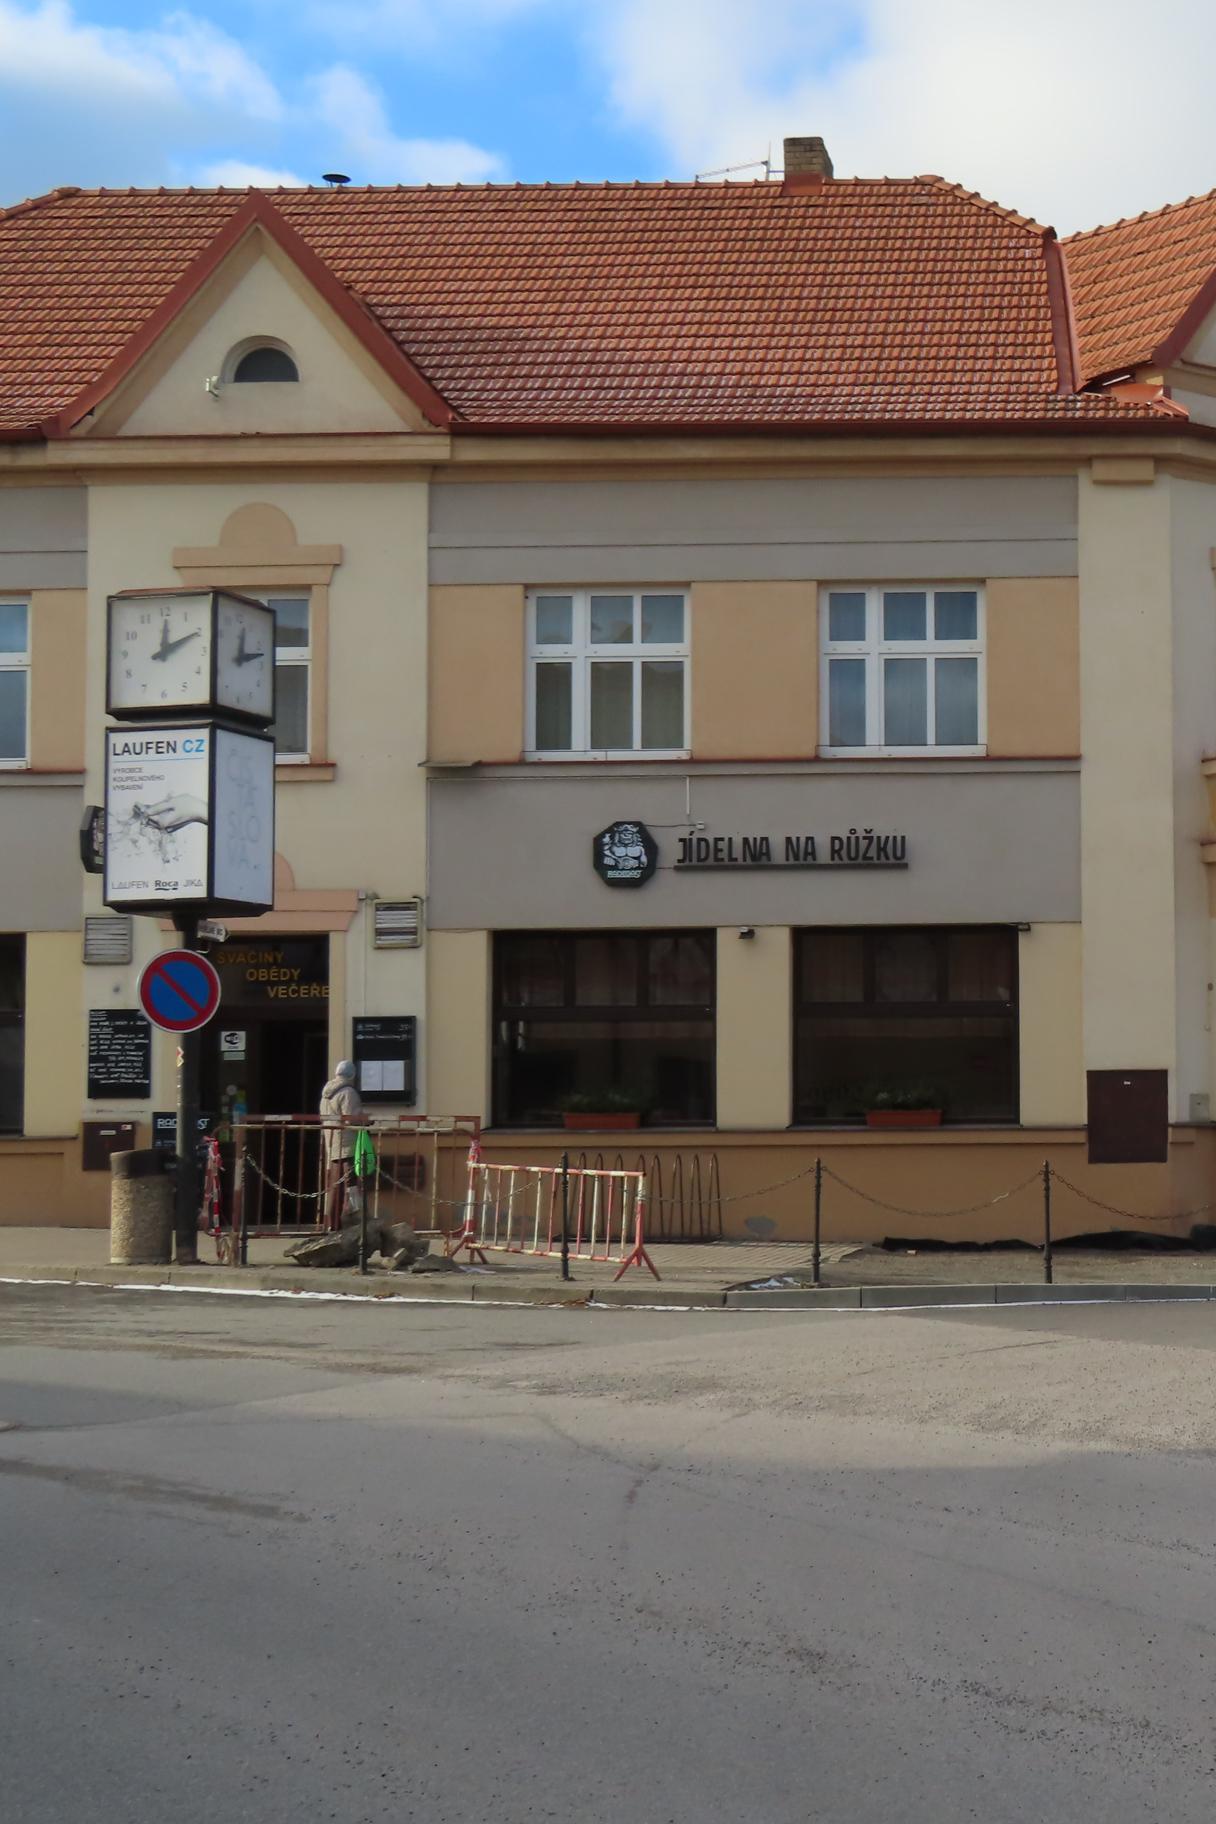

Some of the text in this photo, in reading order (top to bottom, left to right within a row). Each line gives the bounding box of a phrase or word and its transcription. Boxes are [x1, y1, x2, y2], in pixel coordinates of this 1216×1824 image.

[160, 606, 171, 617] 12
[140, 613, 151, 624] 11
[126, 631, 138, 641] 10
[112, 739, 205, 756] LAUFEN CZ
[677, 828, 907, 864] JÍDELNA NA RŮŽKU
[112, 880, 149, 889] LAUFEN
[154, 879, 179, 888] Roca
